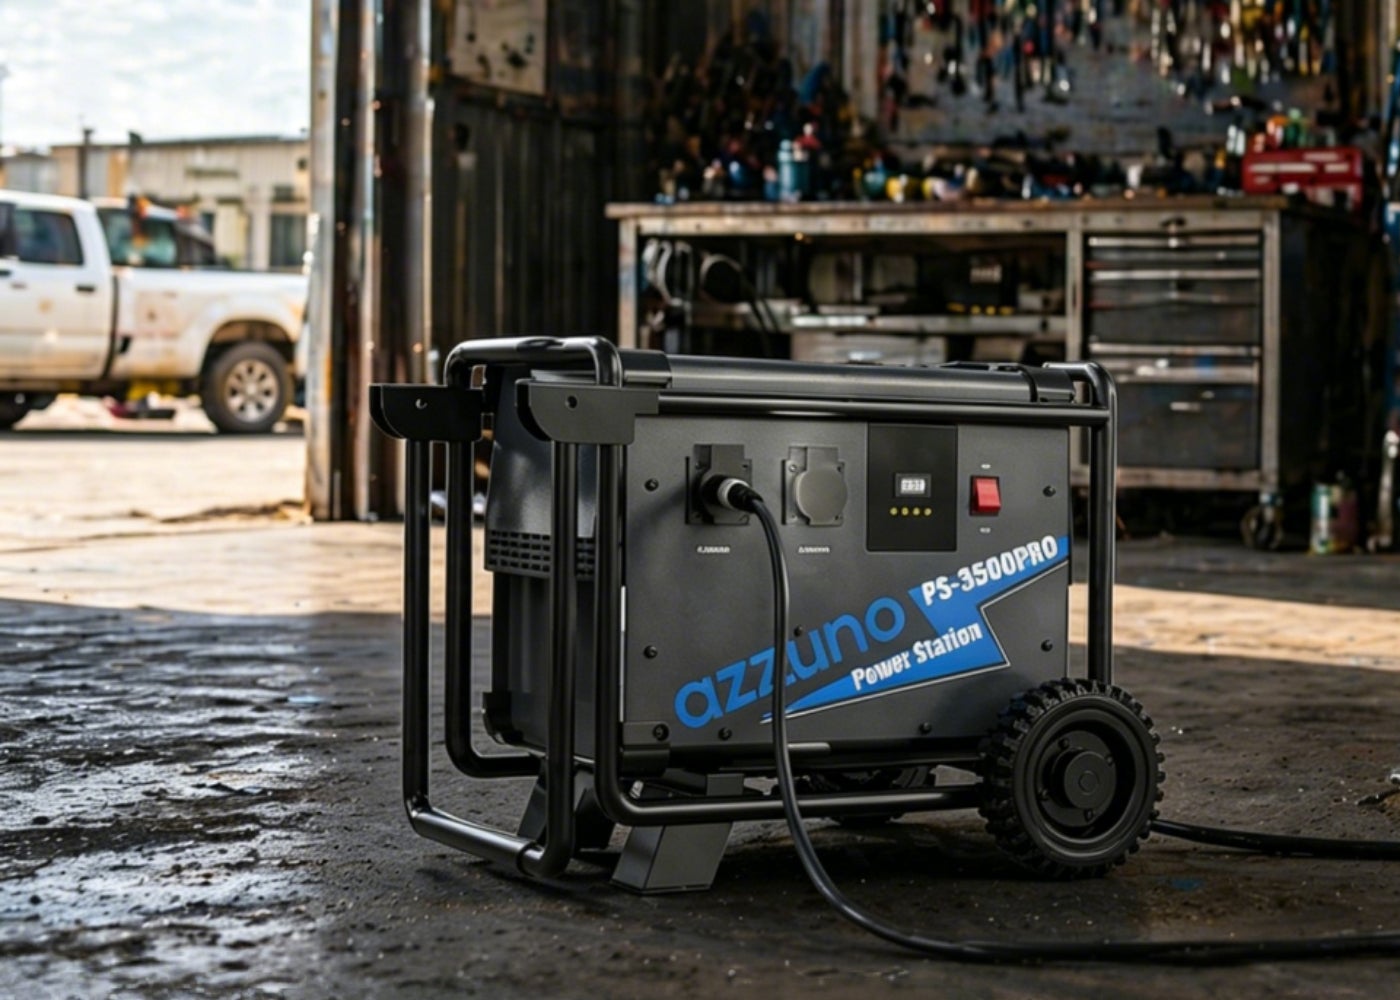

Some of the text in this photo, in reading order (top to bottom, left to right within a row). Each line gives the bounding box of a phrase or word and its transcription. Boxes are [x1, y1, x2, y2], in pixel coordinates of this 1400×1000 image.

[921, 534, 1058, 606] PS-3500PRO
[674, 597, 905, 729] azzuno
[850, 621, 984, 691] Power Station
